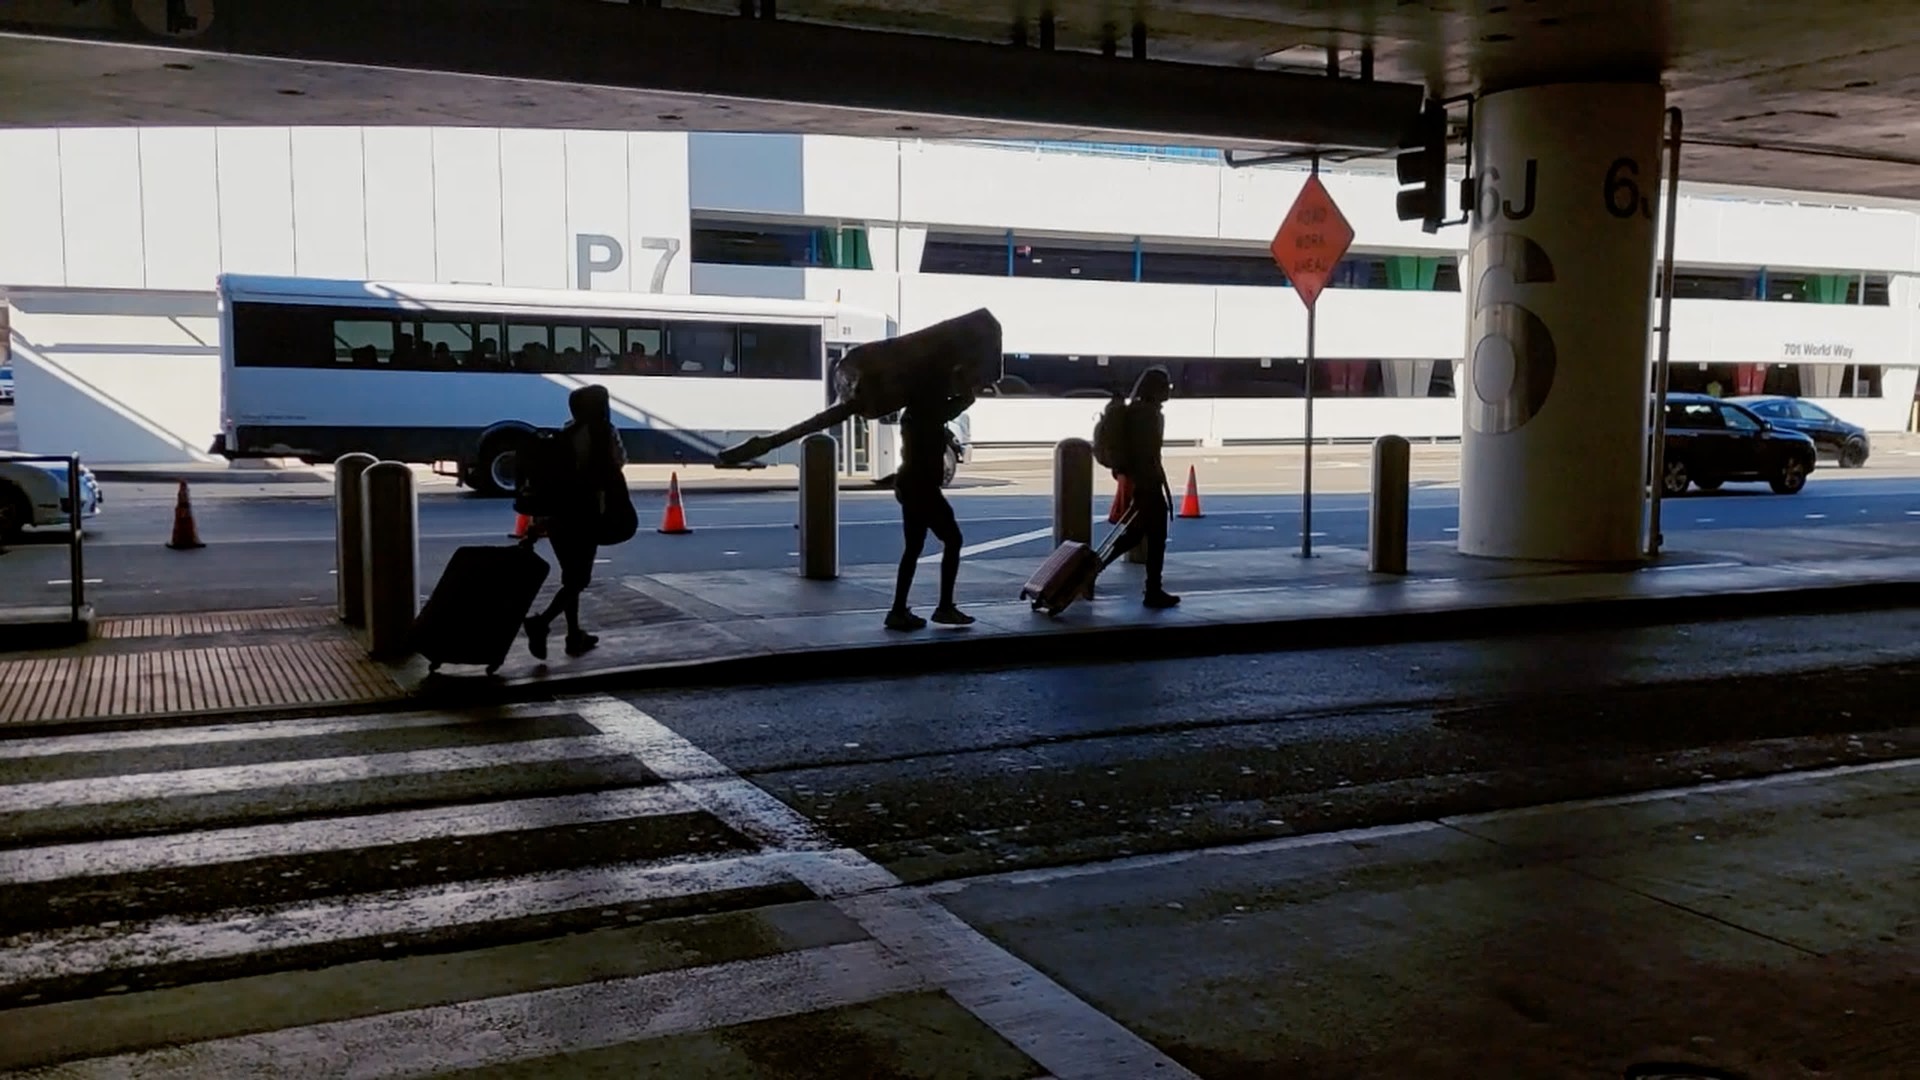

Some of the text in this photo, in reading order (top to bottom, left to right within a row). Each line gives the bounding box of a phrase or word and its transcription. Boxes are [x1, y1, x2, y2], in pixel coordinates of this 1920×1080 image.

[1475, 159, 1537, 226] 6J
[1604, 157, 1652, 219] 6
[1295, 233, 1326, 249] WORK
[1467, 233, 1556, 434] 6
[1803, 343, 1832, 356] World
[1833, 344, 1854, 359] Way
